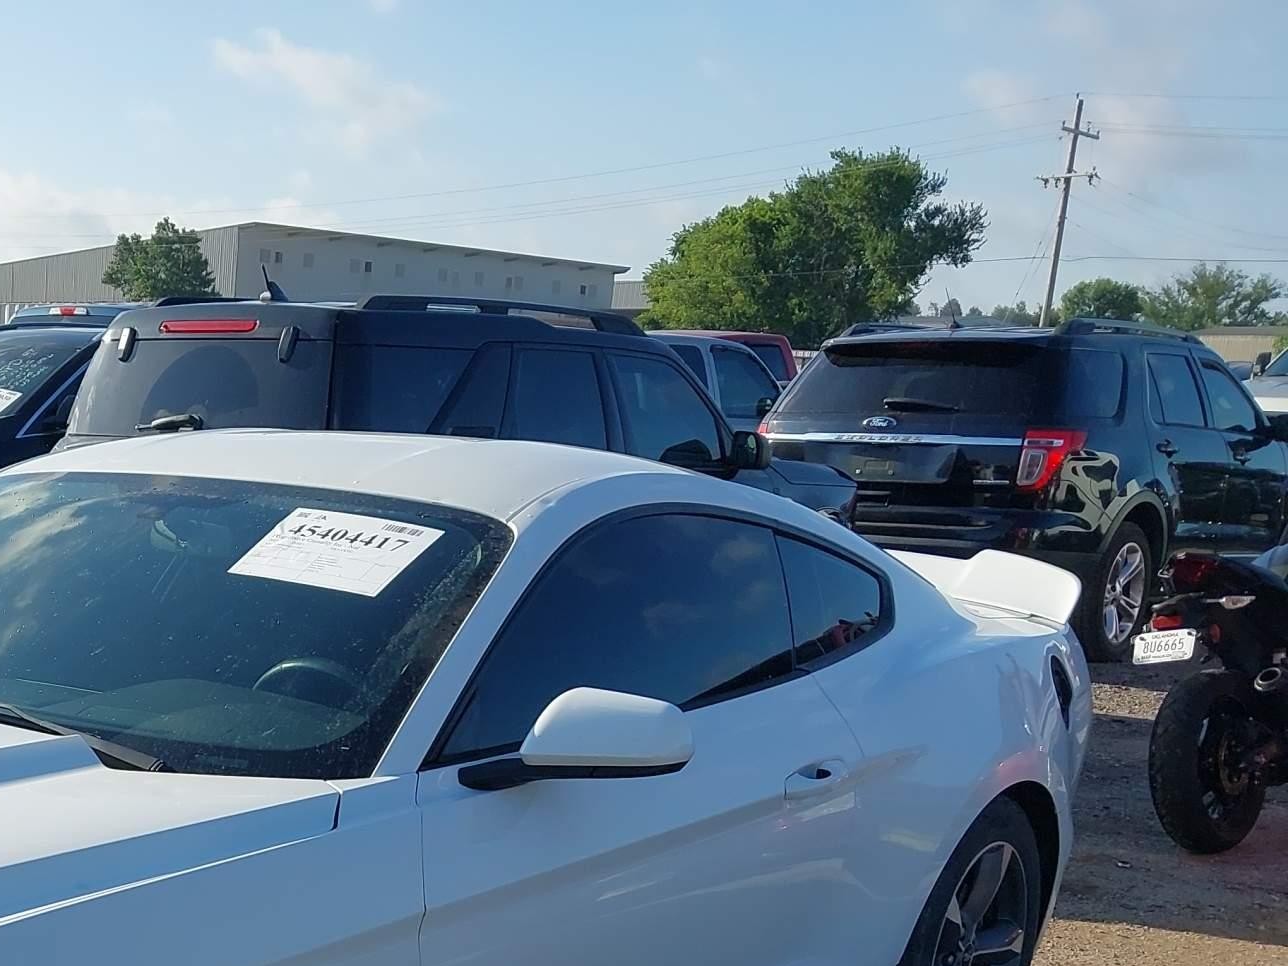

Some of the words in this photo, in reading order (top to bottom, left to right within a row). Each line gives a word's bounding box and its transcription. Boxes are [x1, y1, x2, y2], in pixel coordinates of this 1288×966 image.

[833, 434, 922, 443] EXPLORER
[288, 523, 411, 552] 45404417
[1152, 632, 1179, 640] OKLAHOMA
